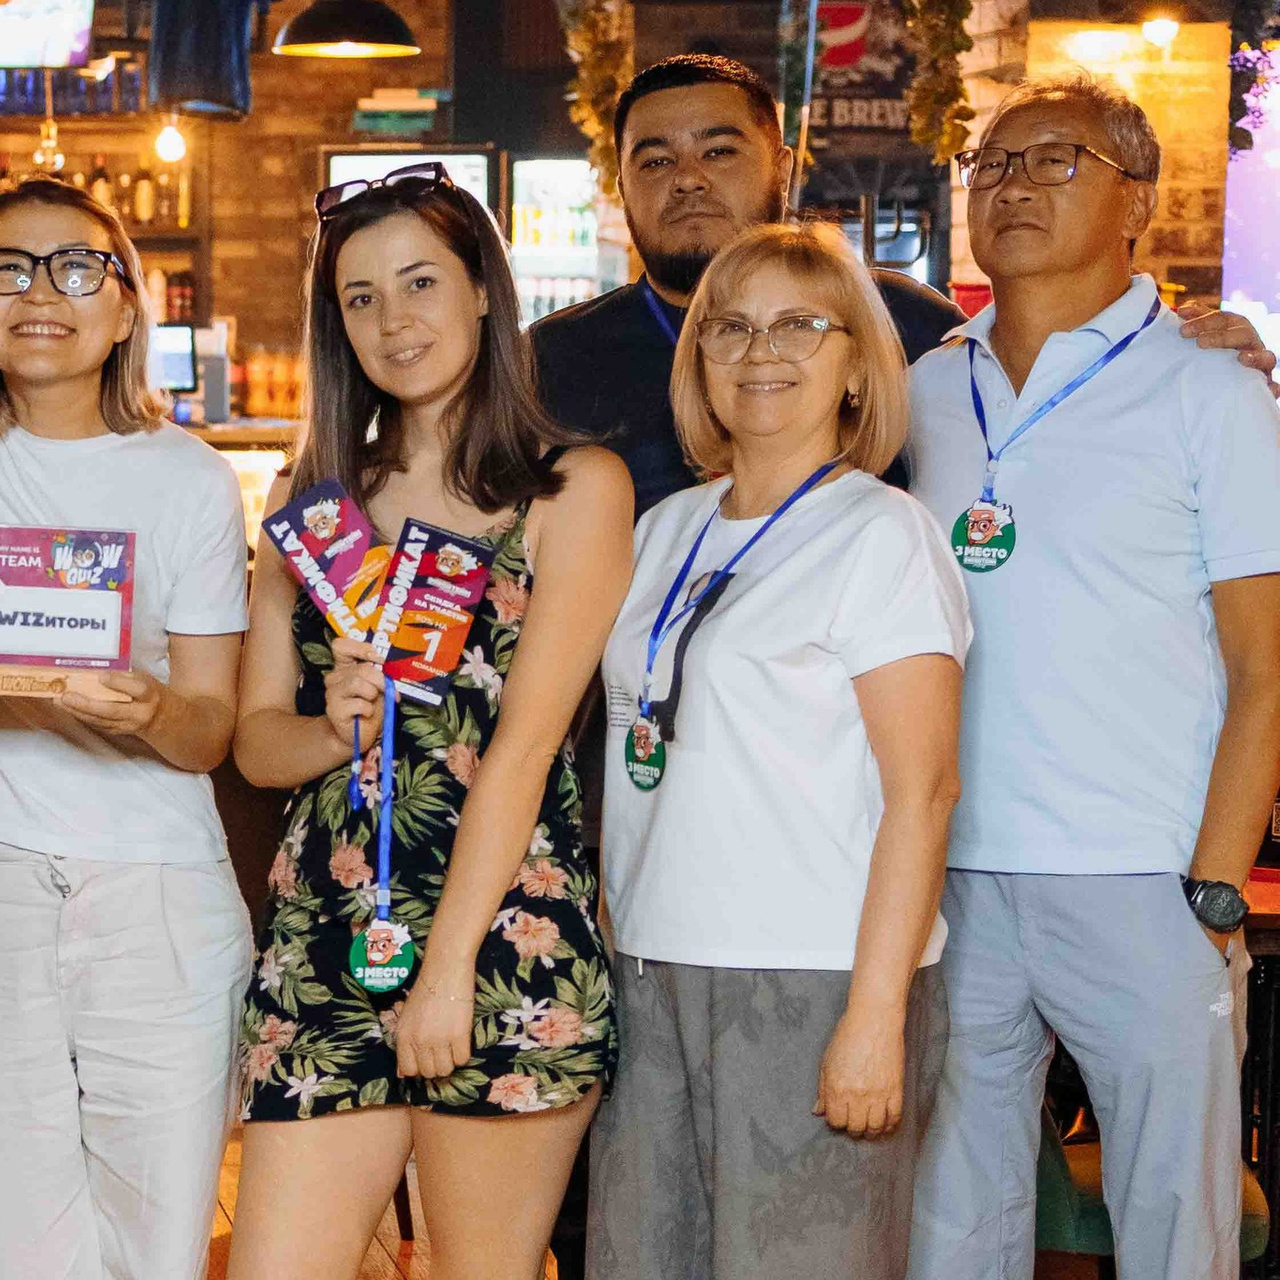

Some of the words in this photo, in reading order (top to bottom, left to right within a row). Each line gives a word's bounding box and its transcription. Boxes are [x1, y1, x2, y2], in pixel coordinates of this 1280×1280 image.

[955, 546, 964, 556] 3
[964, 546, 1008, 559] МЕСТО
[0, 554, 42, 568] TEAM
[66, 567, 104, 585] QUIZ
[423, 630, 442, 663] 1
[633, 763, 660, 778] МЕСТО
[355, 967, 364, 978] 3
[364, 967, 409, 979] МЕСТО
